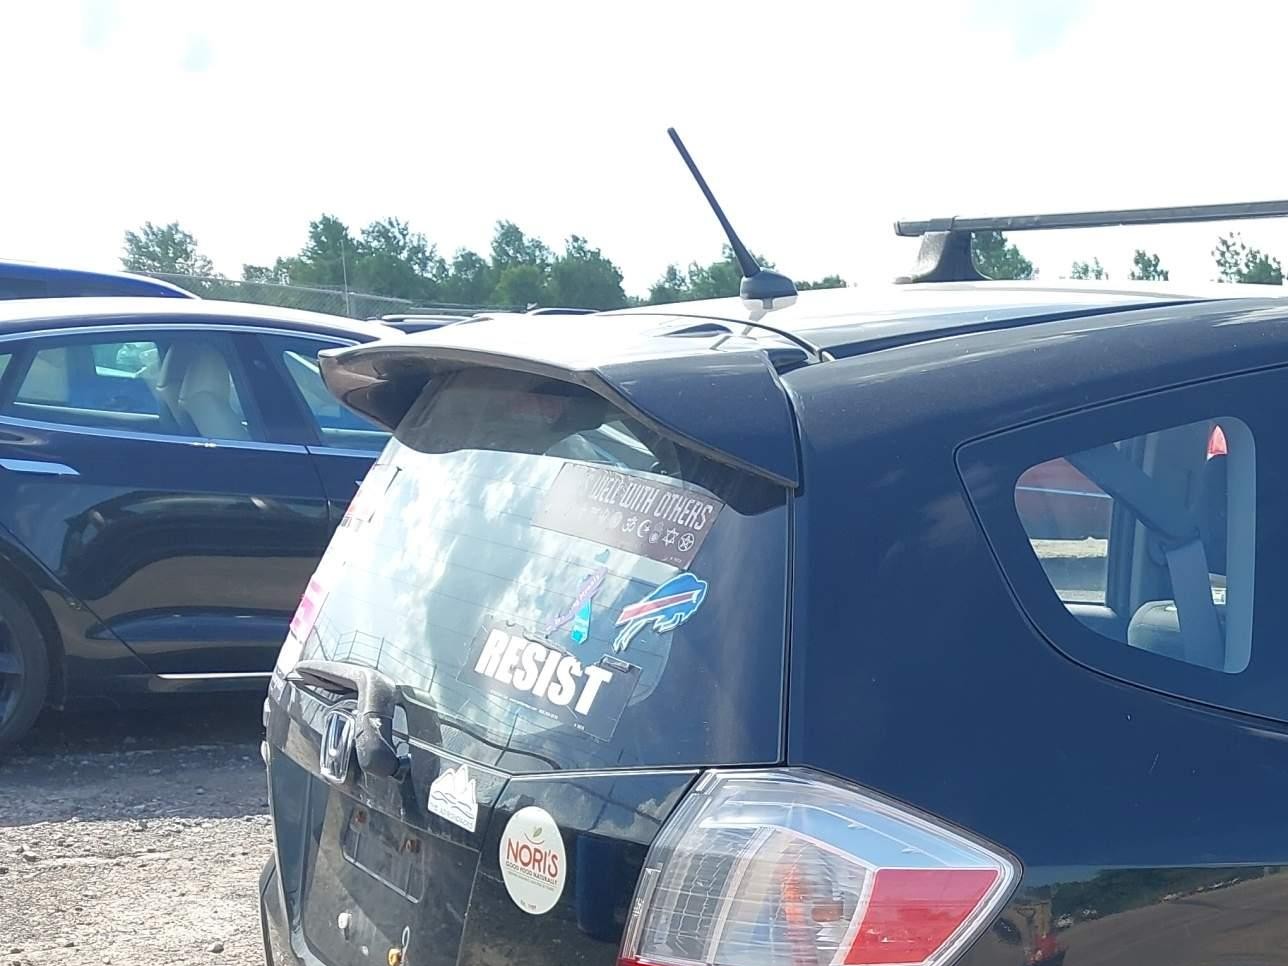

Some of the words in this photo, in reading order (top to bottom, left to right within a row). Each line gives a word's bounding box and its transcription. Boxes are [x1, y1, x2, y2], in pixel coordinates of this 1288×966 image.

[619, 482, 660, 514] WITH
[654, 489, 714, 531] OTHERS
[474, 628, 613, 716] RESIST
[506, 838, 559, 878] NORI'S
